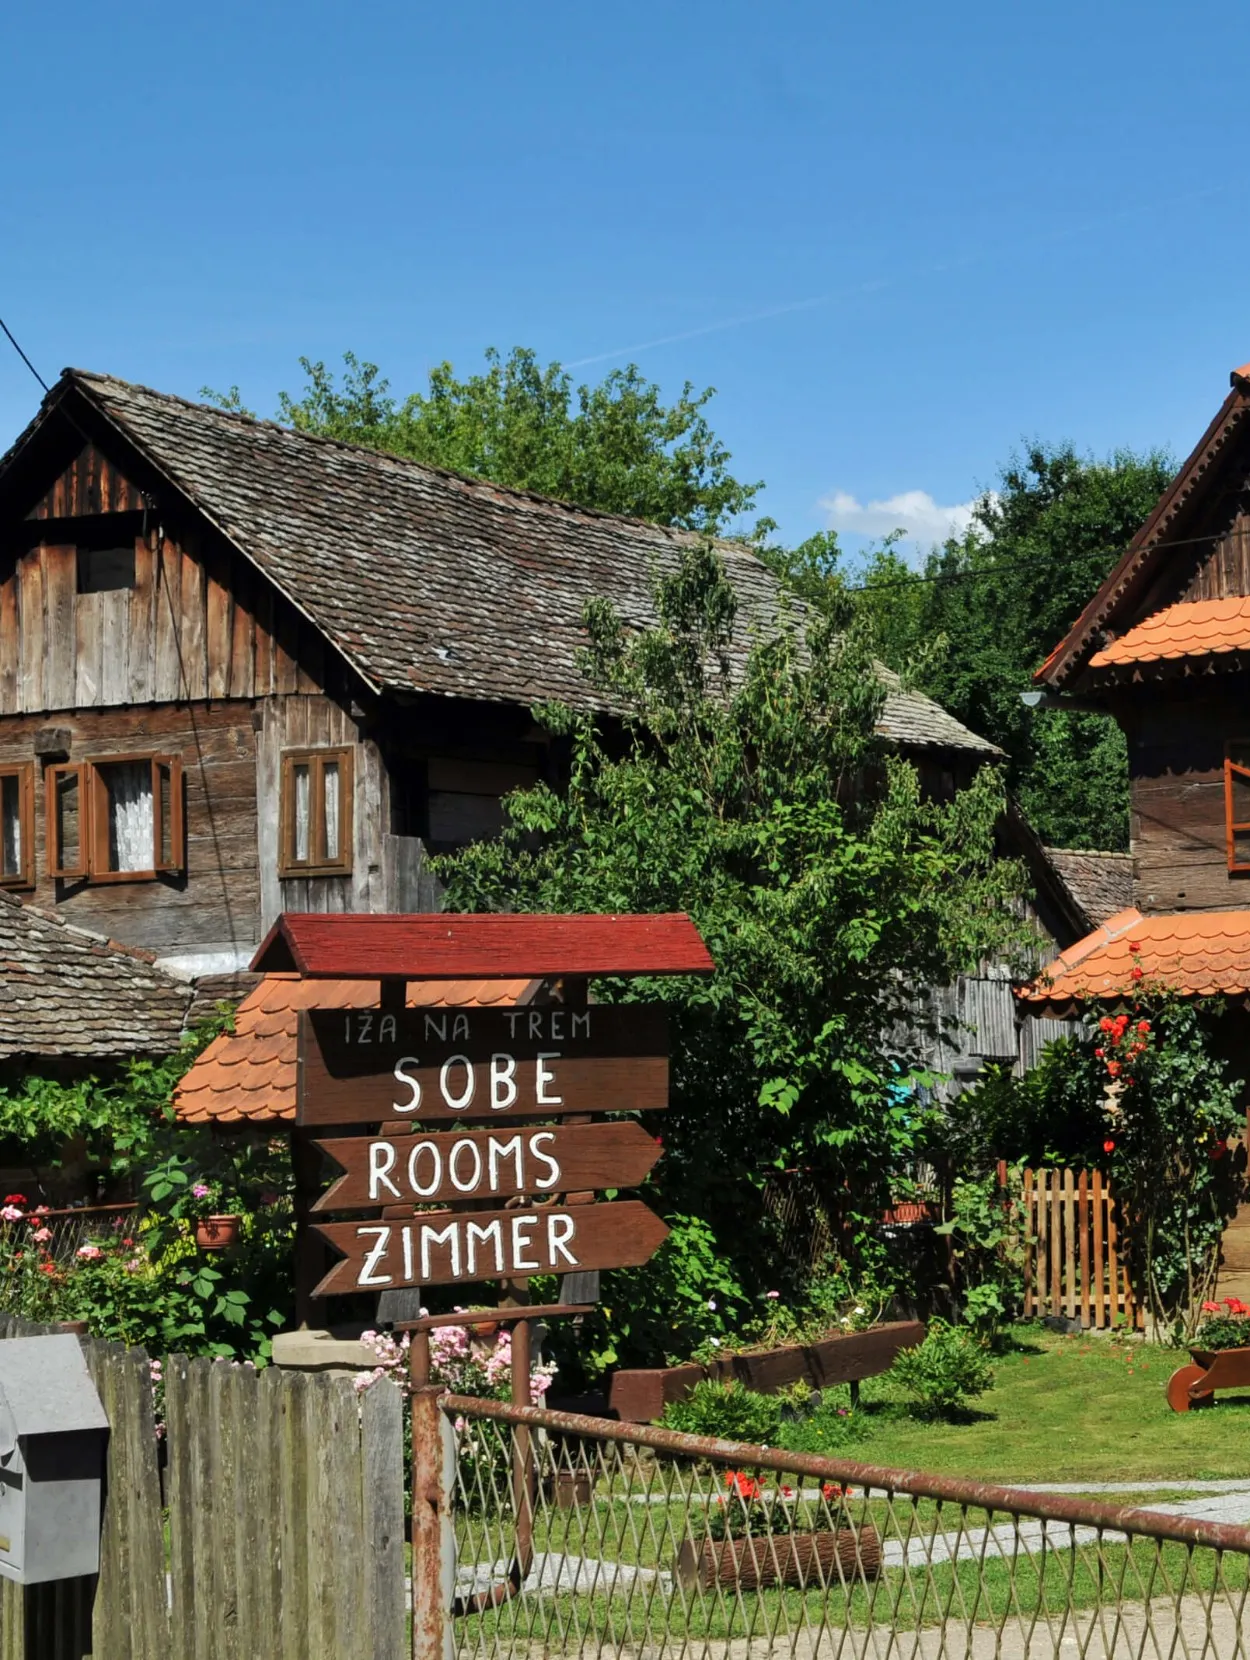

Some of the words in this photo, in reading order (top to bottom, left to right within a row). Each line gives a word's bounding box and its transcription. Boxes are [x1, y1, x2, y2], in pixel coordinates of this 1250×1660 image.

[424, 1014, 469, 1041] NA
[503, 1011, 591, 1040] TREM
[392, 1052, 563, 1113] SOBE
[368, 1131, 561, 1200] ROOMS
[357, 1213, 580, 1286] ZIMMER
